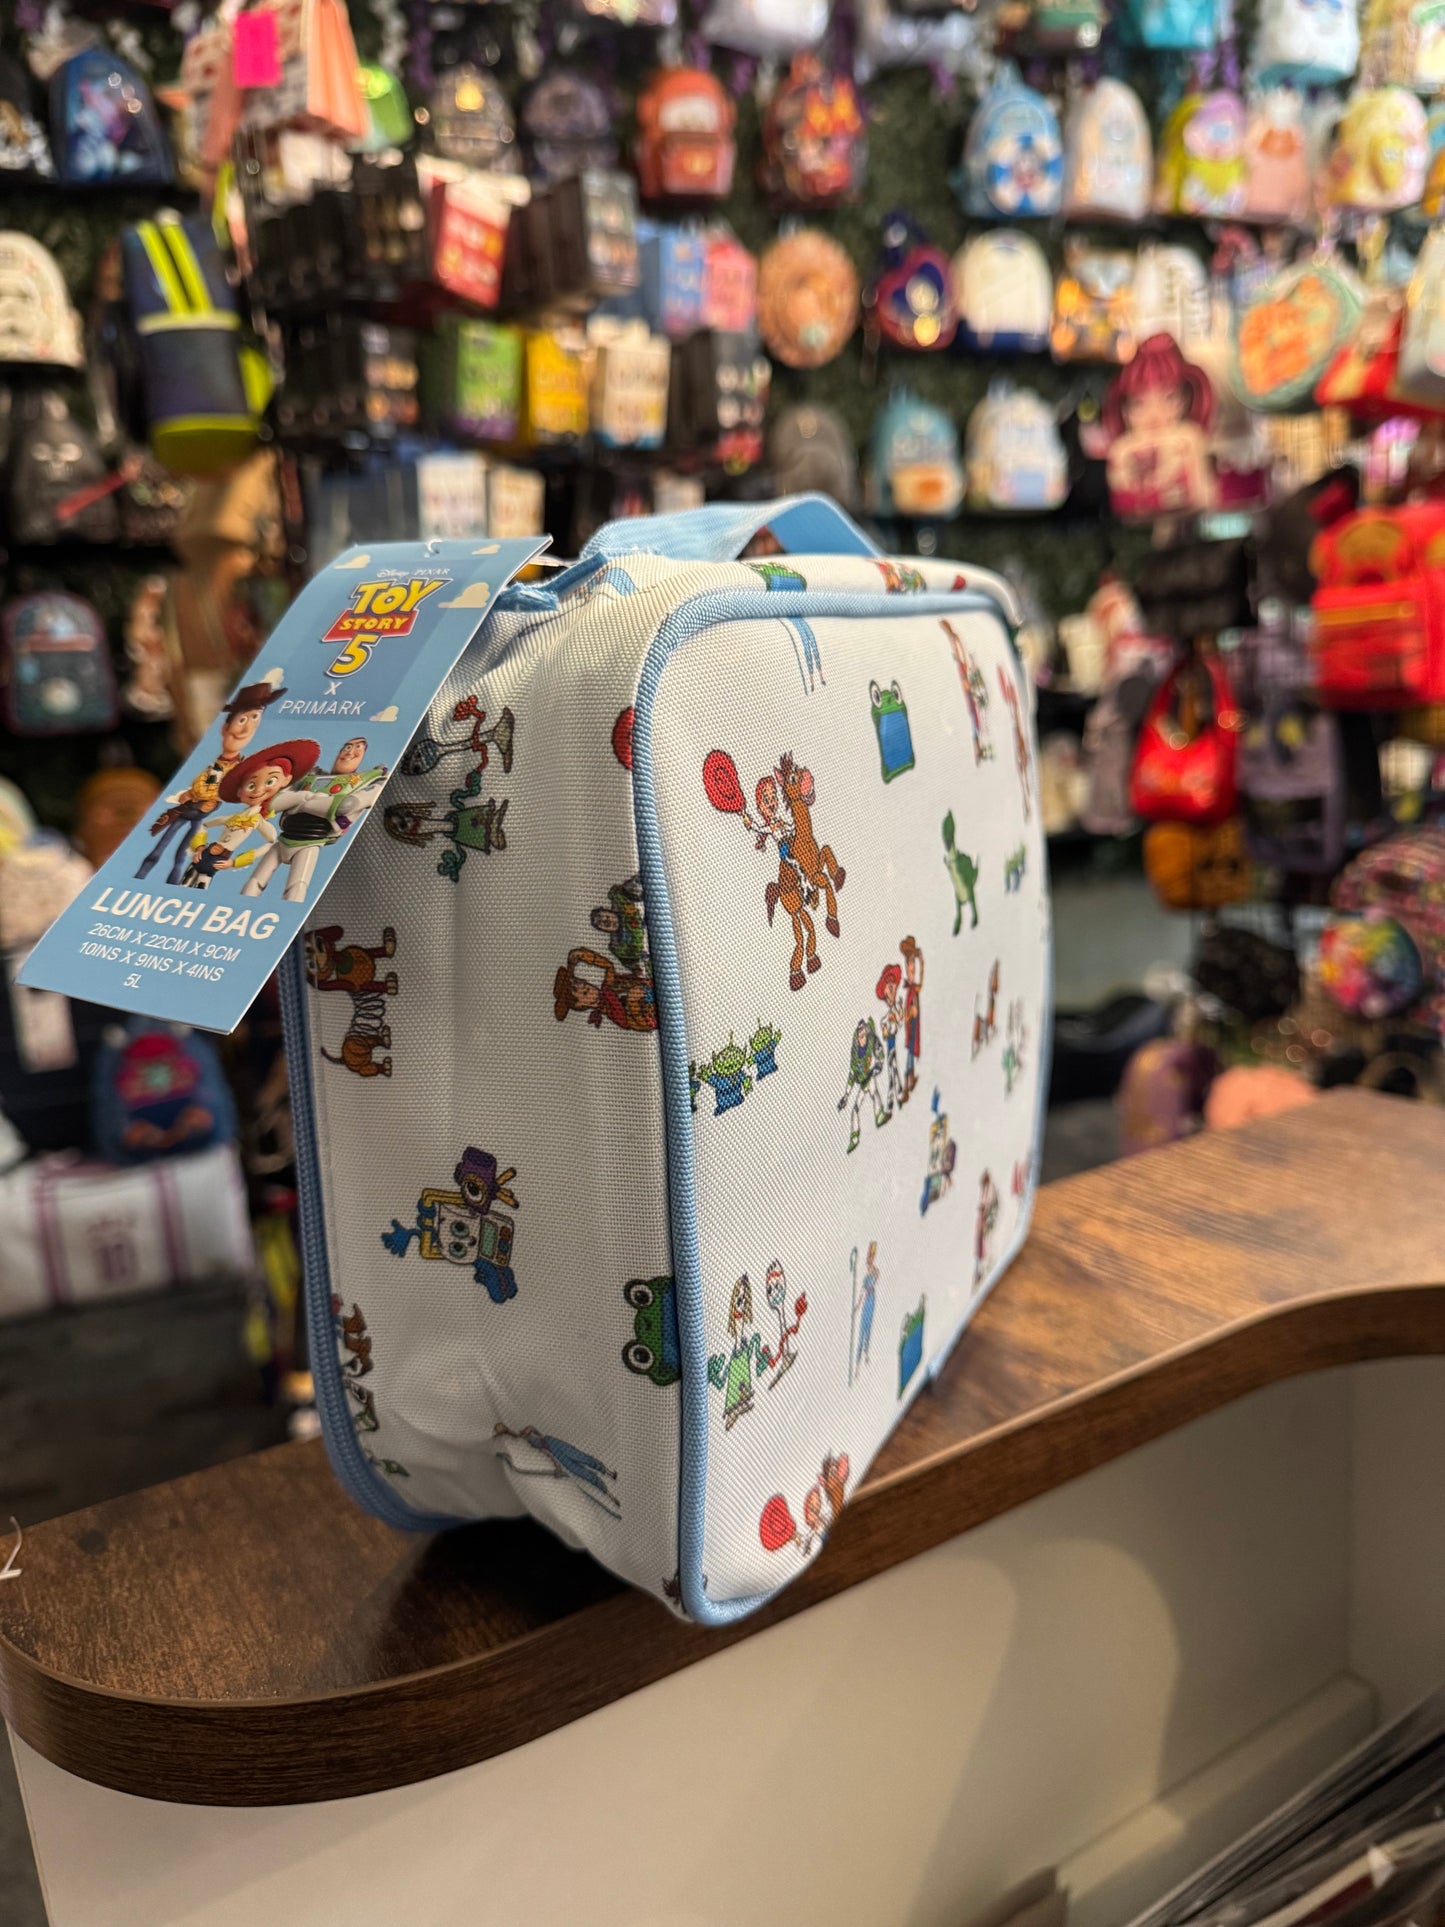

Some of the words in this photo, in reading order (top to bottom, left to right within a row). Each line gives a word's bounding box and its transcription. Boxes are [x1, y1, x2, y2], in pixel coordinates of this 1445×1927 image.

[413, 568, 451, 576] PIXAR
[350, 578, 453, 615] TOY
[339, 617, 409, 631] STORY
[326, 633, 382, 678] 5
[278, 700, 367, 716] PRIMARK
[91, 887, 206, 929] LUNCH
[201, 905, 280, 940] BAG
[88, 922, 133, 942] 26CM
[144, 934, 190, 953] 22CM
[203, 944, 242, 962] 9CM
[79, 941, 122, 961] 10INS
[134, 953, 173, 972] 9INS
[186, 963, 225, 982] 4INS
[123, 973, 143, 989] 5L
